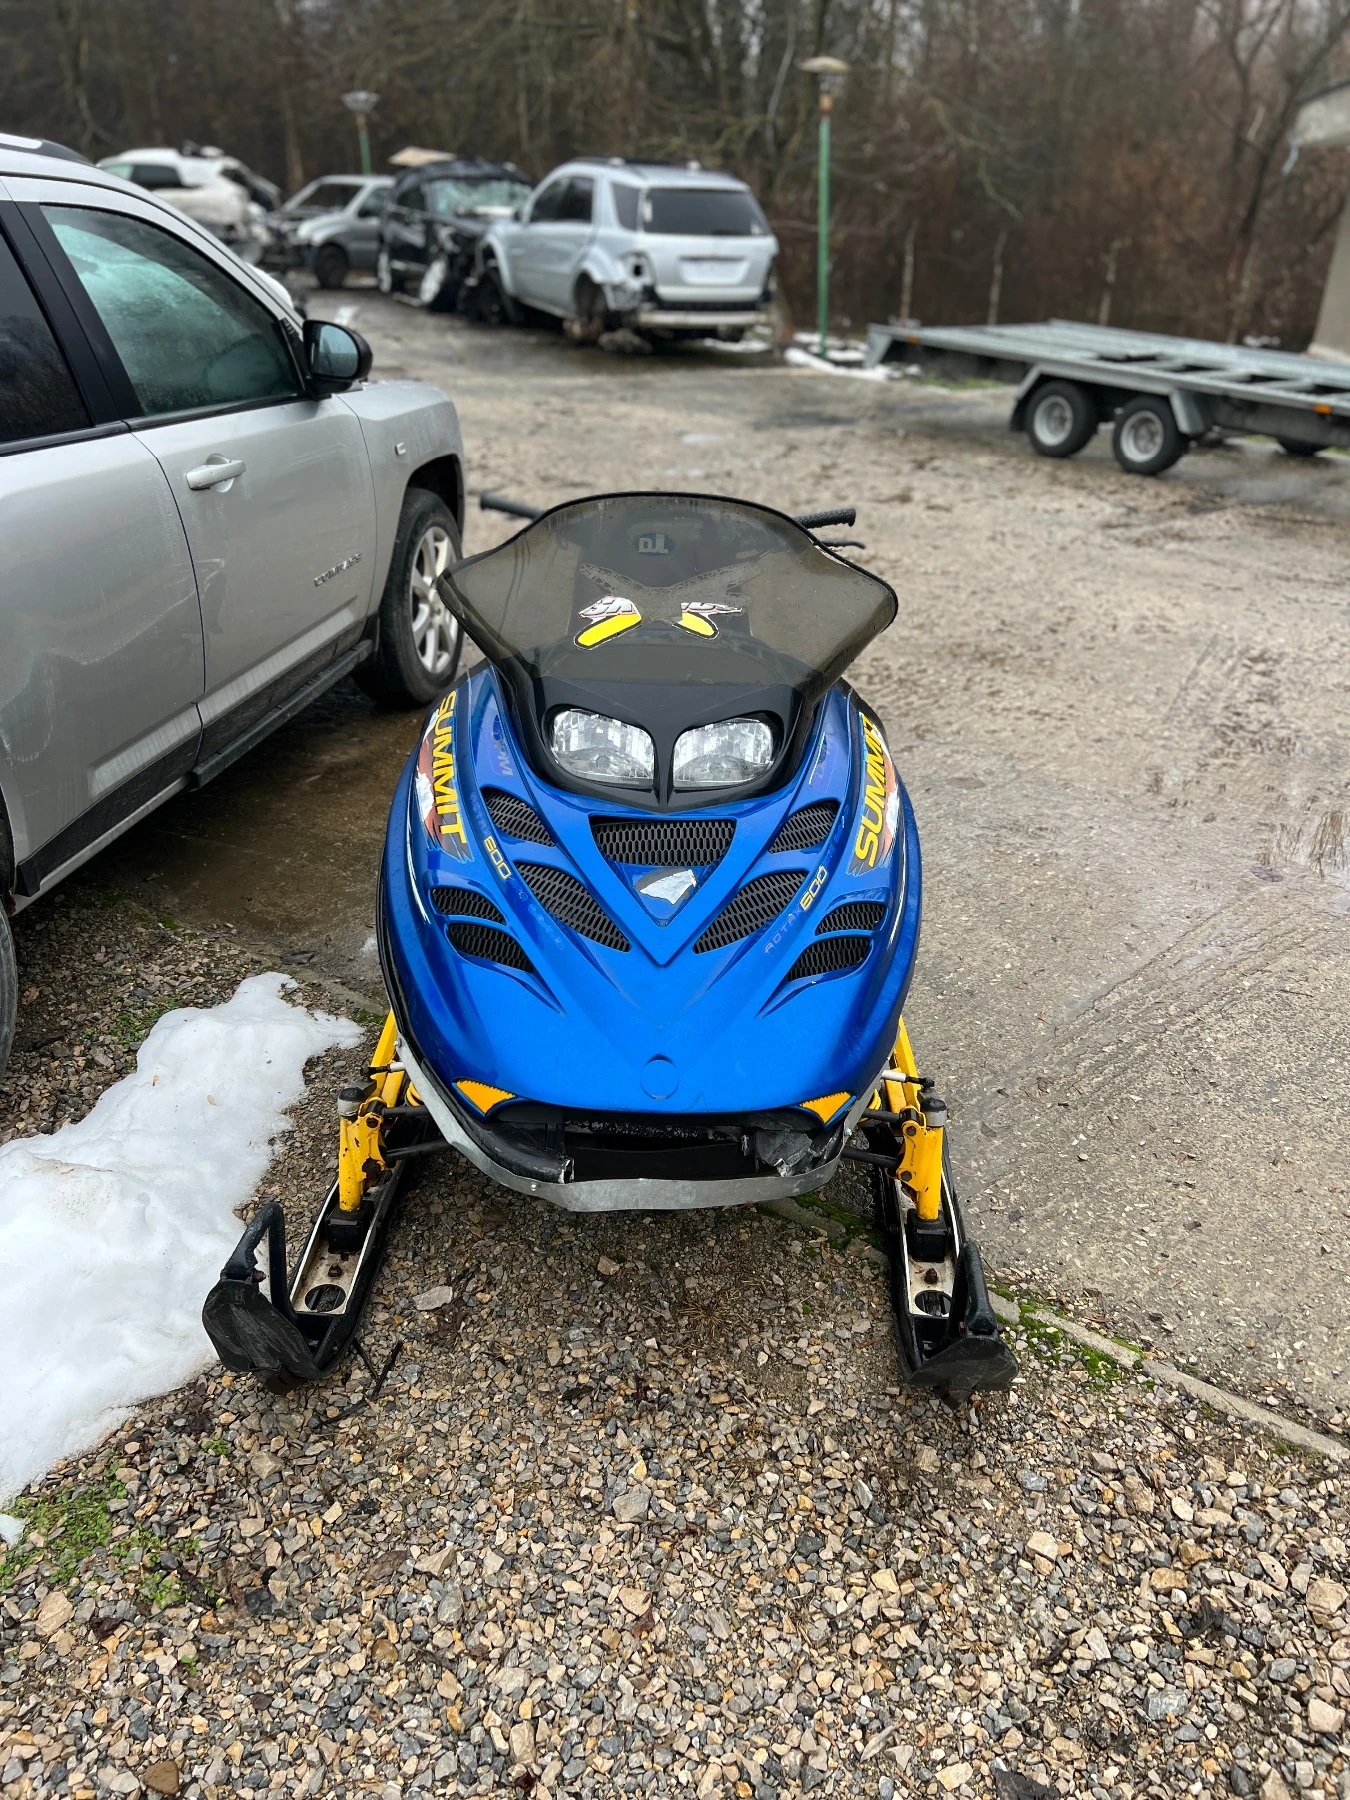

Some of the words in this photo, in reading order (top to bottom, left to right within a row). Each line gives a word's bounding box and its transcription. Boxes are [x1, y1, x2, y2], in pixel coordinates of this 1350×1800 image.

[432, 690, 467, 844] SUMMIT
[855, 713, 887, 867] SUMMIT
[484, 836, 513, 880] 600
[800, 865, 829, 911] 600
